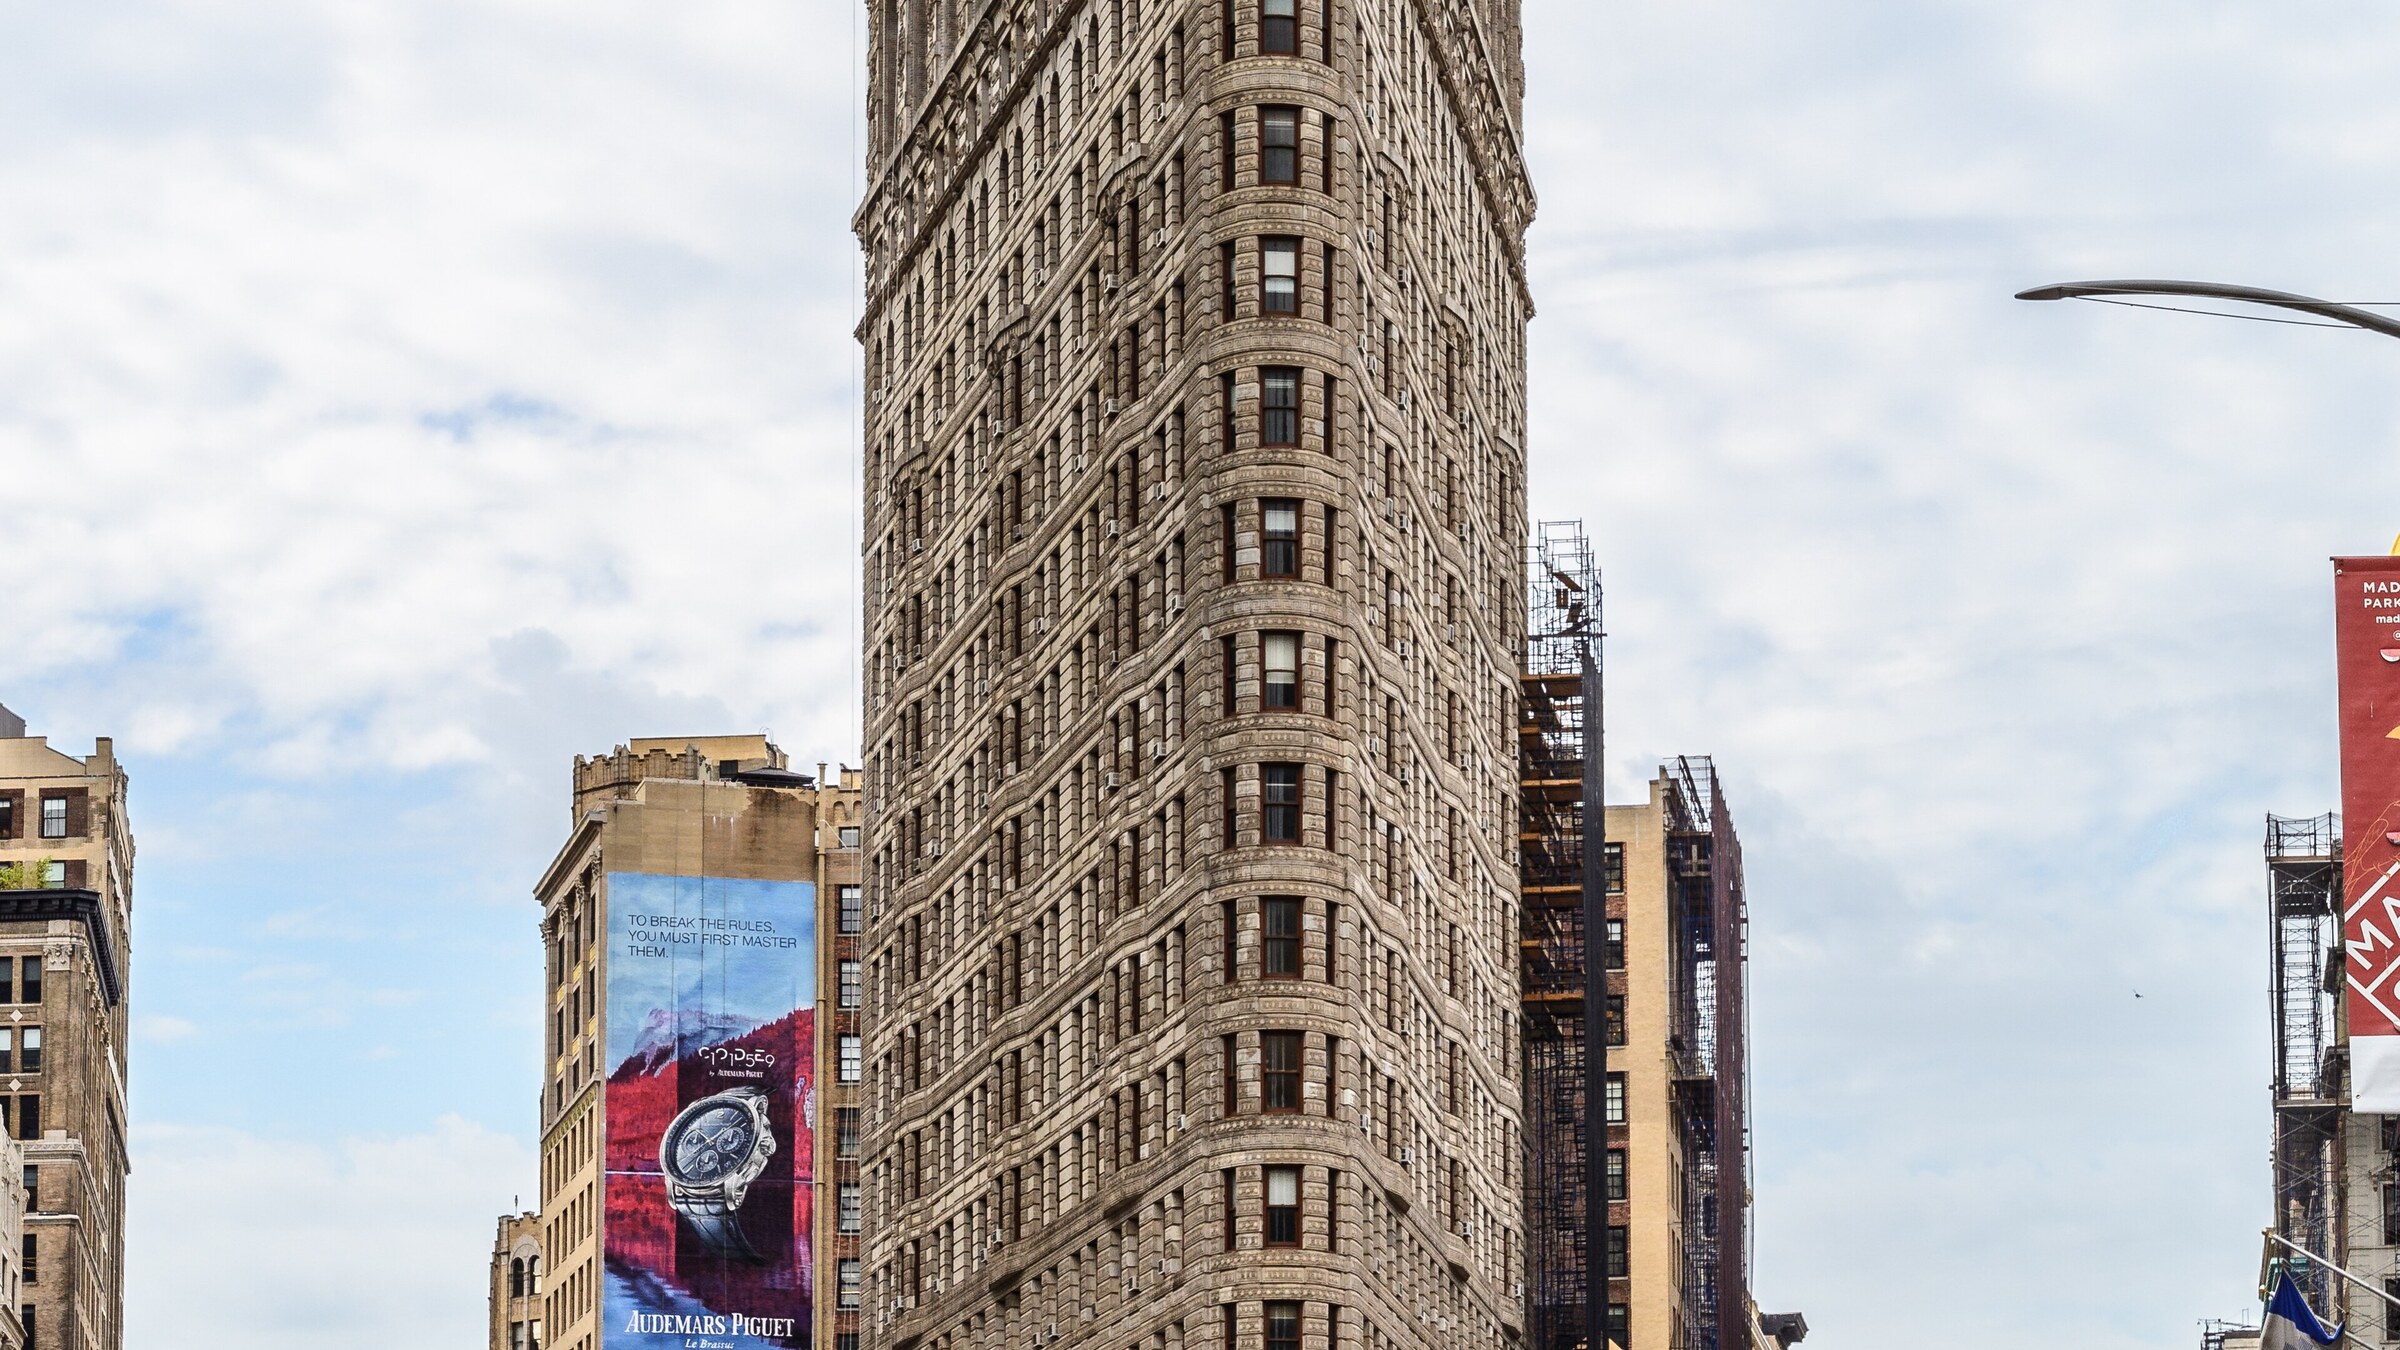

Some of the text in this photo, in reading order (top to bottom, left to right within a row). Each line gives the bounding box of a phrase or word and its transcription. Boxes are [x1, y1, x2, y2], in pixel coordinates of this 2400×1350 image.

[628, 914, 776, 934] TO BREAK THE RULES,
[628, 930, 797, 949] YOU MUST FIRST MASTER
[628, 945, 669, 959] THEM.
[717, 1069, 745, 1078] AUDEMARS
[745, 1070, 764, 1079] PIGUET
[624, 1310, 795, 1337] AUDEMARS PIGUET
[685, 1338, 735, 1350] Le Brassus
